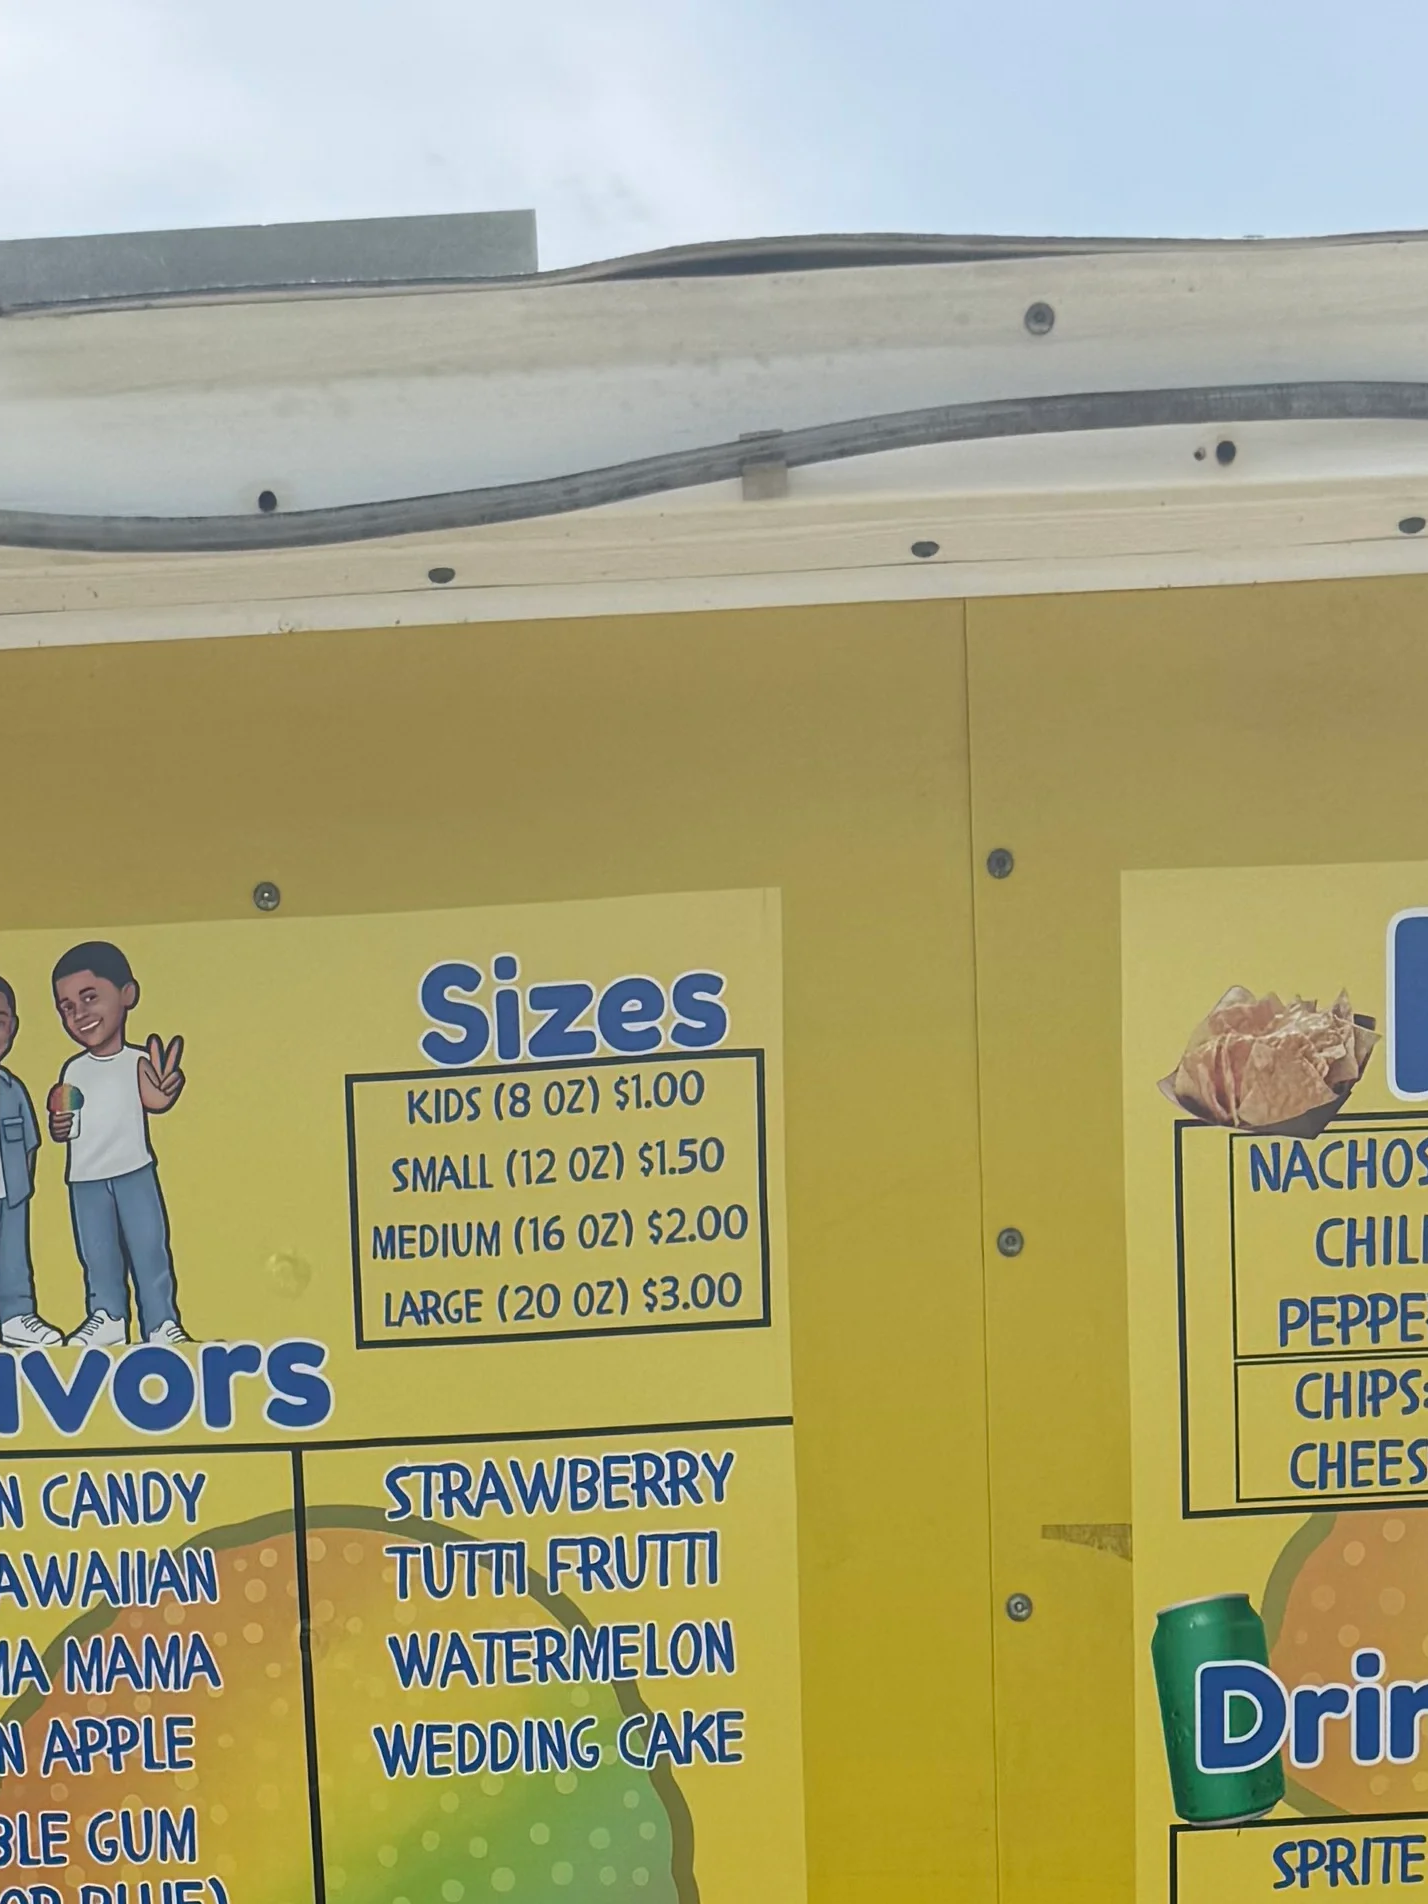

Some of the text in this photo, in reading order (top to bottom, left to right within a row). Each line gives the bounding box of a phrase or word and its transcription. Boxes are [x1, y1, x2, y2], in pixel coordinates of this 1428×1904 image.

[422, 957, 726, 1064] Sizes
[408, 1071, 704, 1123] KIDS (8 OZ) $1.00
[392, 1139, 724, 1191] SMALL (12 OZ) $1.50
[373, 1206, 747, 1259] MEDIUM (16 OZ) $2.00
[385, 1273, 741, 1326] LARGE (20 OZ) $3.00
[43, 1472, 205, 1528] CANDY
[386, 1451, 733, 1519] STRAWBERRY
[386, 1531, 717, 1599] TUTTI FRUTTI
[63, 1634, 221, 1692] MAMA
[389, 1621, 734, 1688] WATERMELON
[43, 1717, 193, 1775] APPLE
[374, 1711, 743, 1777] WEDDING CAKE
[88, 1808, 195, 1862] GUM
